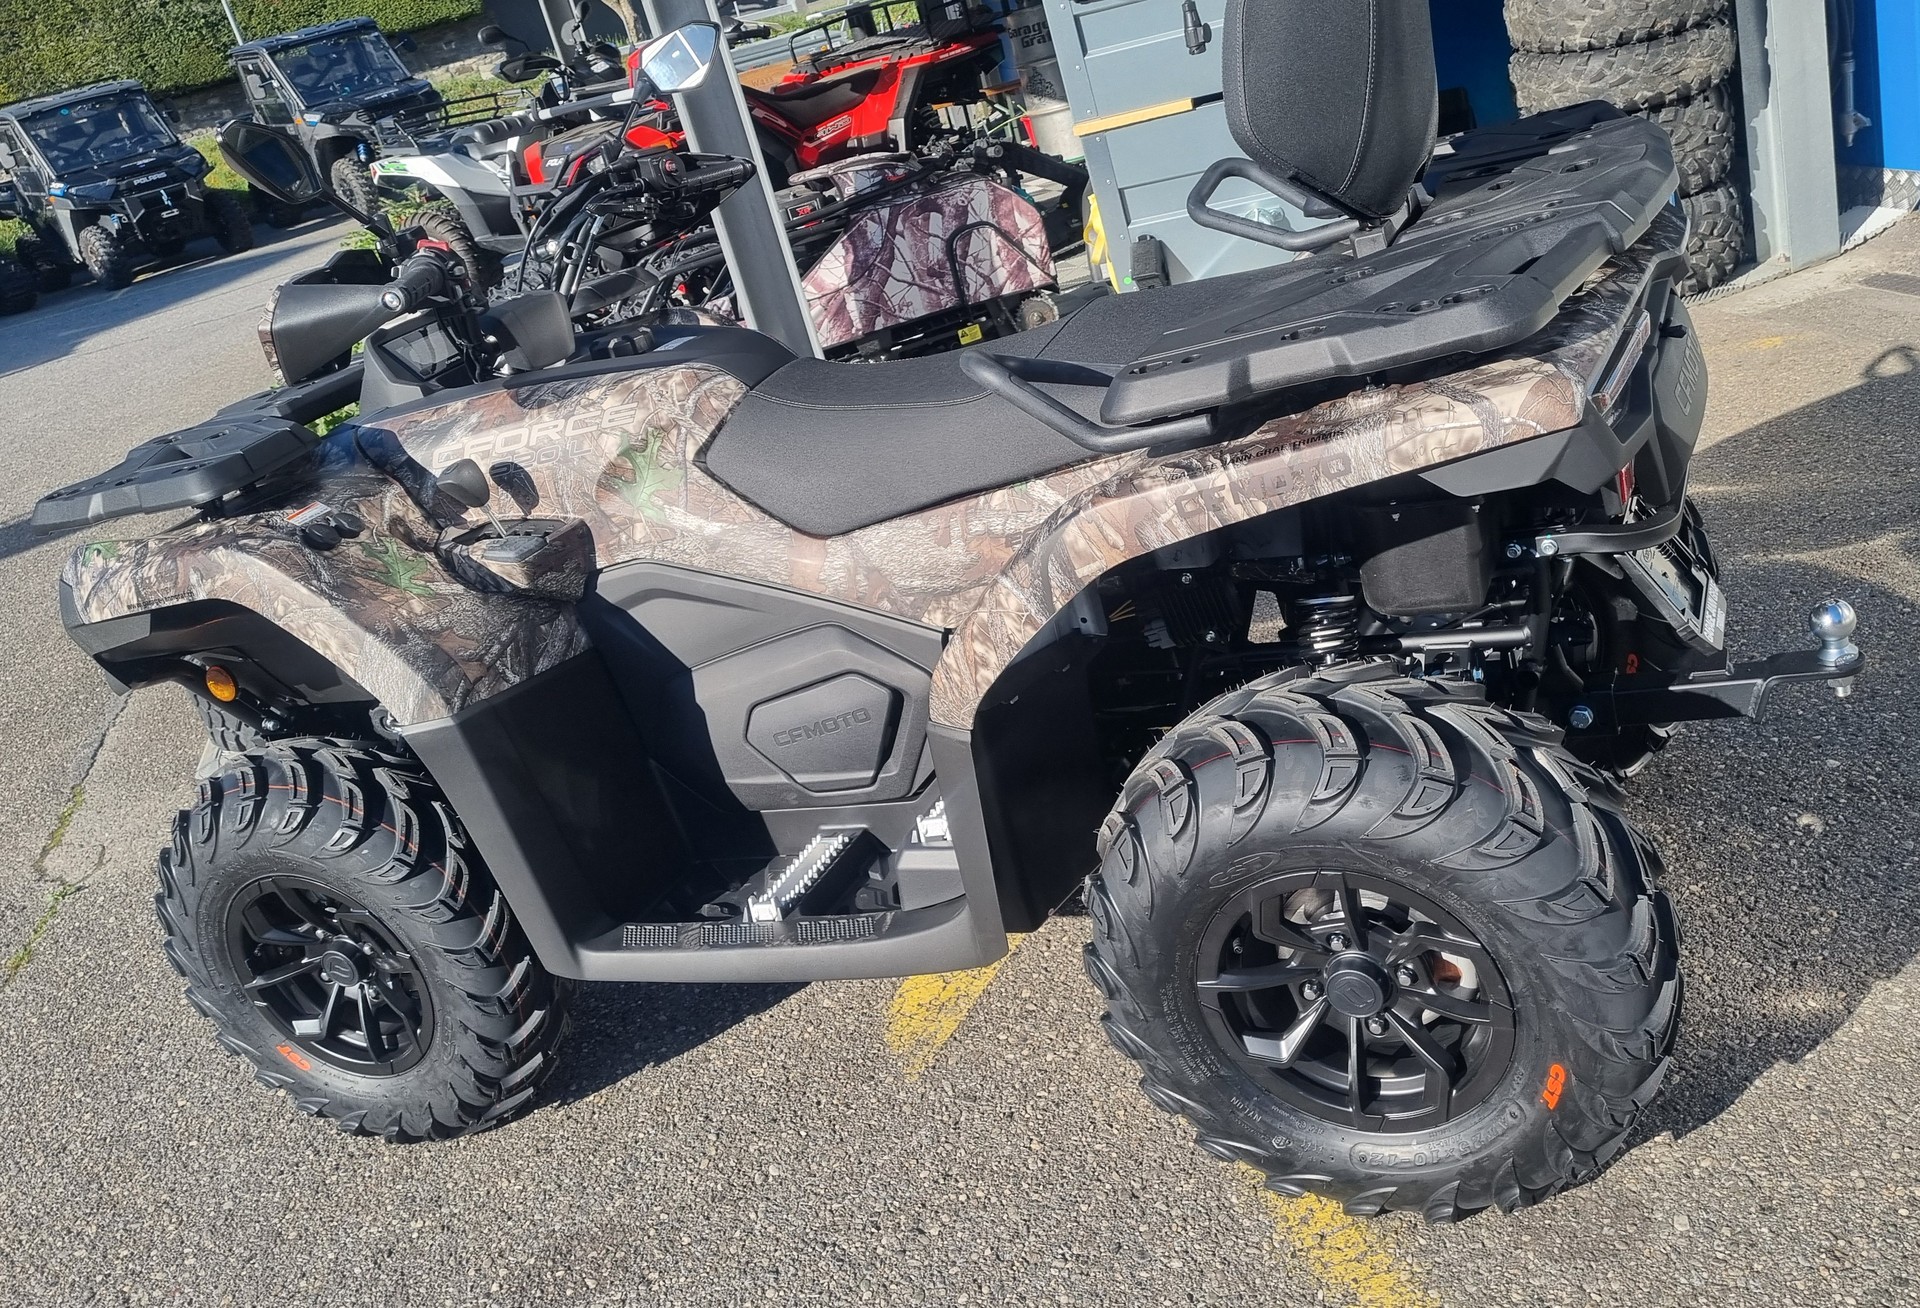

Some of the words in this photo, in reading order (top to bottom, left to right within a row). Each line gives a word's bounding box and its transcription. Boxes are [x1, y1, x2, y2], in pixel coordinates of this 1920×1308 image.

[133, 171, 168, 186] POLARIS
[432, 402, 640, 469] CFORCE
[1176, 453, 1351, 517] CFMOTO
[772, 707, 873, 749] CFMOTO
[276, 1045, 311, 1071] CST
[1541, 1064, 1566, 1110] CST
